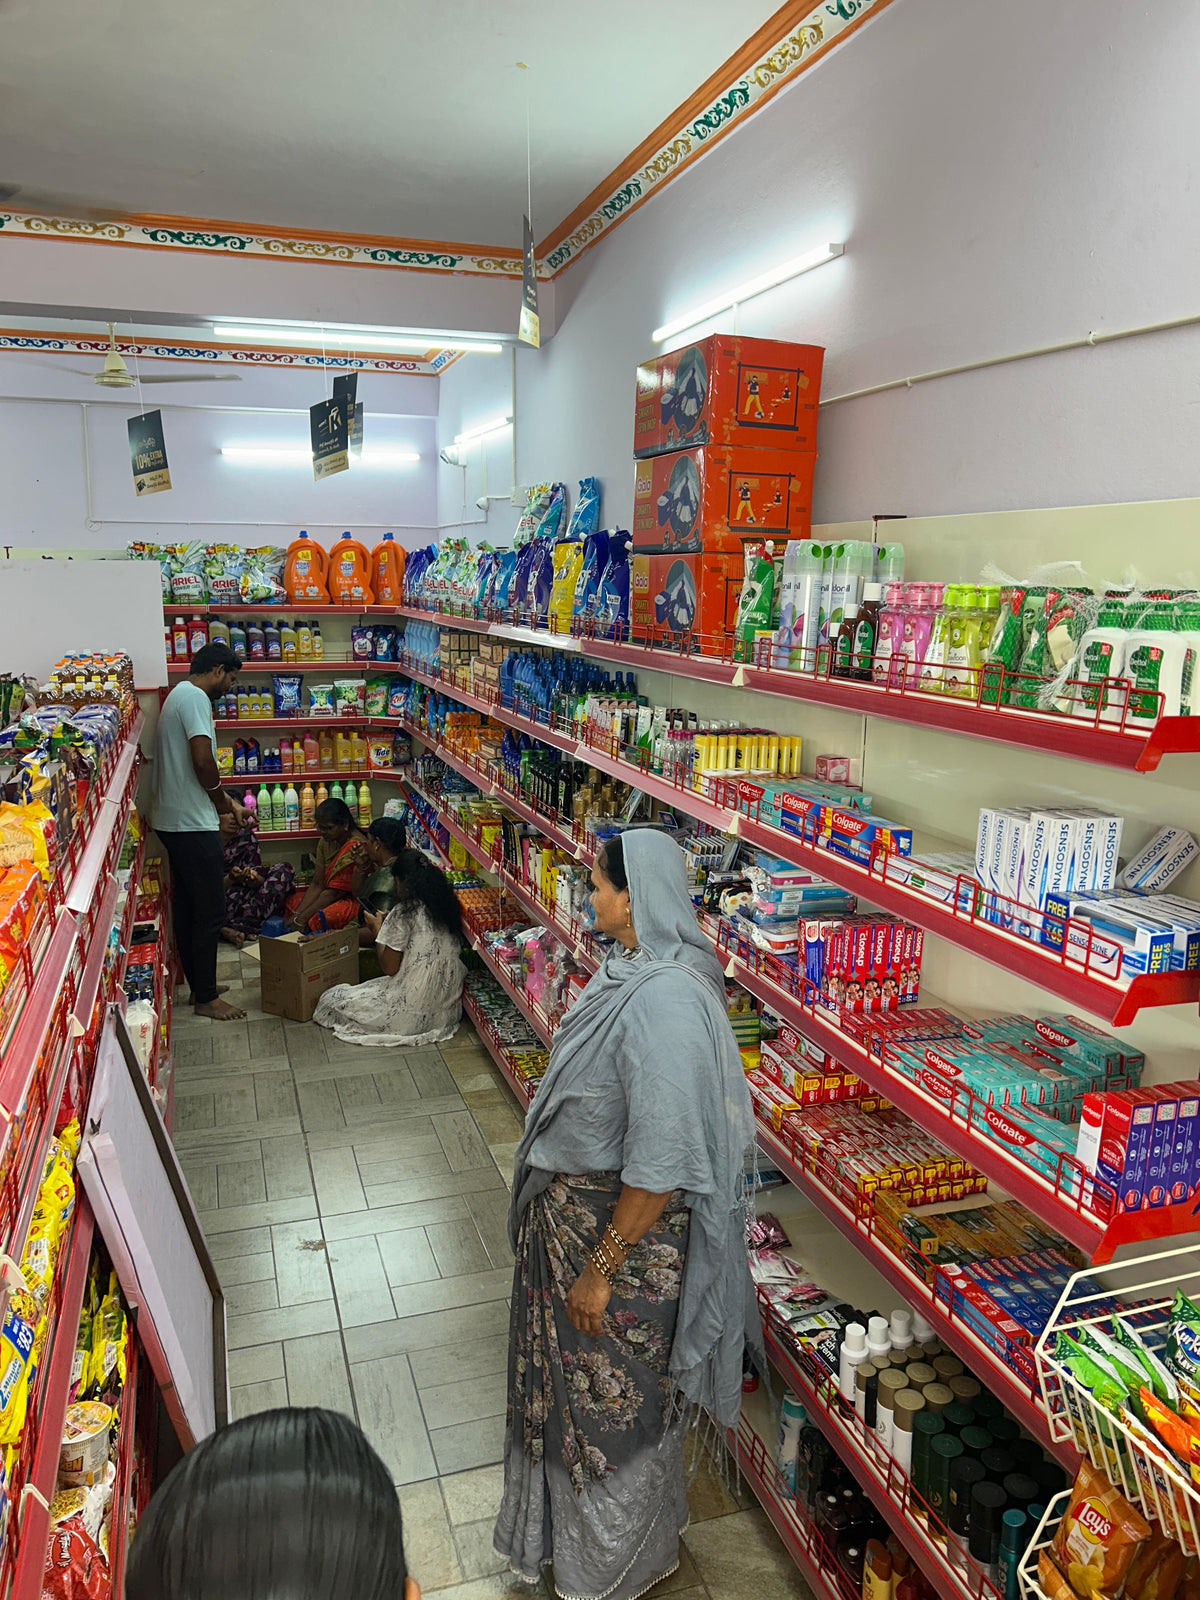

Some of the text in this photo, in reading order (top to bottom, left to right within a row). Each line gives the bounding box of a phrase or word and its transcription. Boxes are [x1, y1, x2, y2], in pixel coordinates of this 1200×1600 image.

[135, 452, 151, 470] 10%
[637, 476, 651, 492] Gala
[172, 576, 200, 587] ARIEL
[212, 579, 239, 589] ARIEL
[634, 571, 649, 589] Gala
[1130, 659, 1147, 668] Dettol
[391, 694, 406, 705] Rin
[374, 747, 391, 758] Tide
[783, 793, 811, 812] Colgate
[832, 812, 863, 834] Colgate
[978, 814, 989, 871] SENSODYNE
[993, 818, 1005, 878] SENSODYNE
[1009, 826, 1021, 882] SENSODYNE
[1027, 819, 1045, 891] SENSODYNE
[1051, 823, 1070, 894] SENSODYNE
[1079, 822, 1095, 892] SENSODYNE
[1101, 821, 1118, 891] SENSODYNE
[1126, 830, 1176, 881] SENSODYNE
[1148, 842, 1194, 891] SENSODYN
[1046, 899, 1068, 919] FREE
[855, 932, 868, 968] closeup
[874, 930, 886, 966] closeup
[891, 929, 904, 964] closeup
[904, 933, 913, 961] closeup
[914, 931, 924, 959] closeup
[140, 1022, 149, 1040] Silky
[781, 1029, 798, 1046] RED
[962, 1024, 982, 1039] Colgate
[1036, 1022, 1070, 1047] Colgate
[762, 1056, 778, 1075] RED
[926, 1051, 958, 1077] Colgate
[1082, 1105, 1102, 1120] Colgate
[1106, 1105, 1130, 1122] Colgate
[986, 1110, 1028, 1146] Colgate
[1102, 1146, 1122, 1163] VISIBLE
[1102, 1153, 1120, 1167] WHITE
[1174, 1350, 1197, 1374] PLAYZ
[4, 1357, 19, 1394] Minute
[1121, 1415, 1132, 1430] 10
[1078, 1502, 1111, 1537] Lay's
